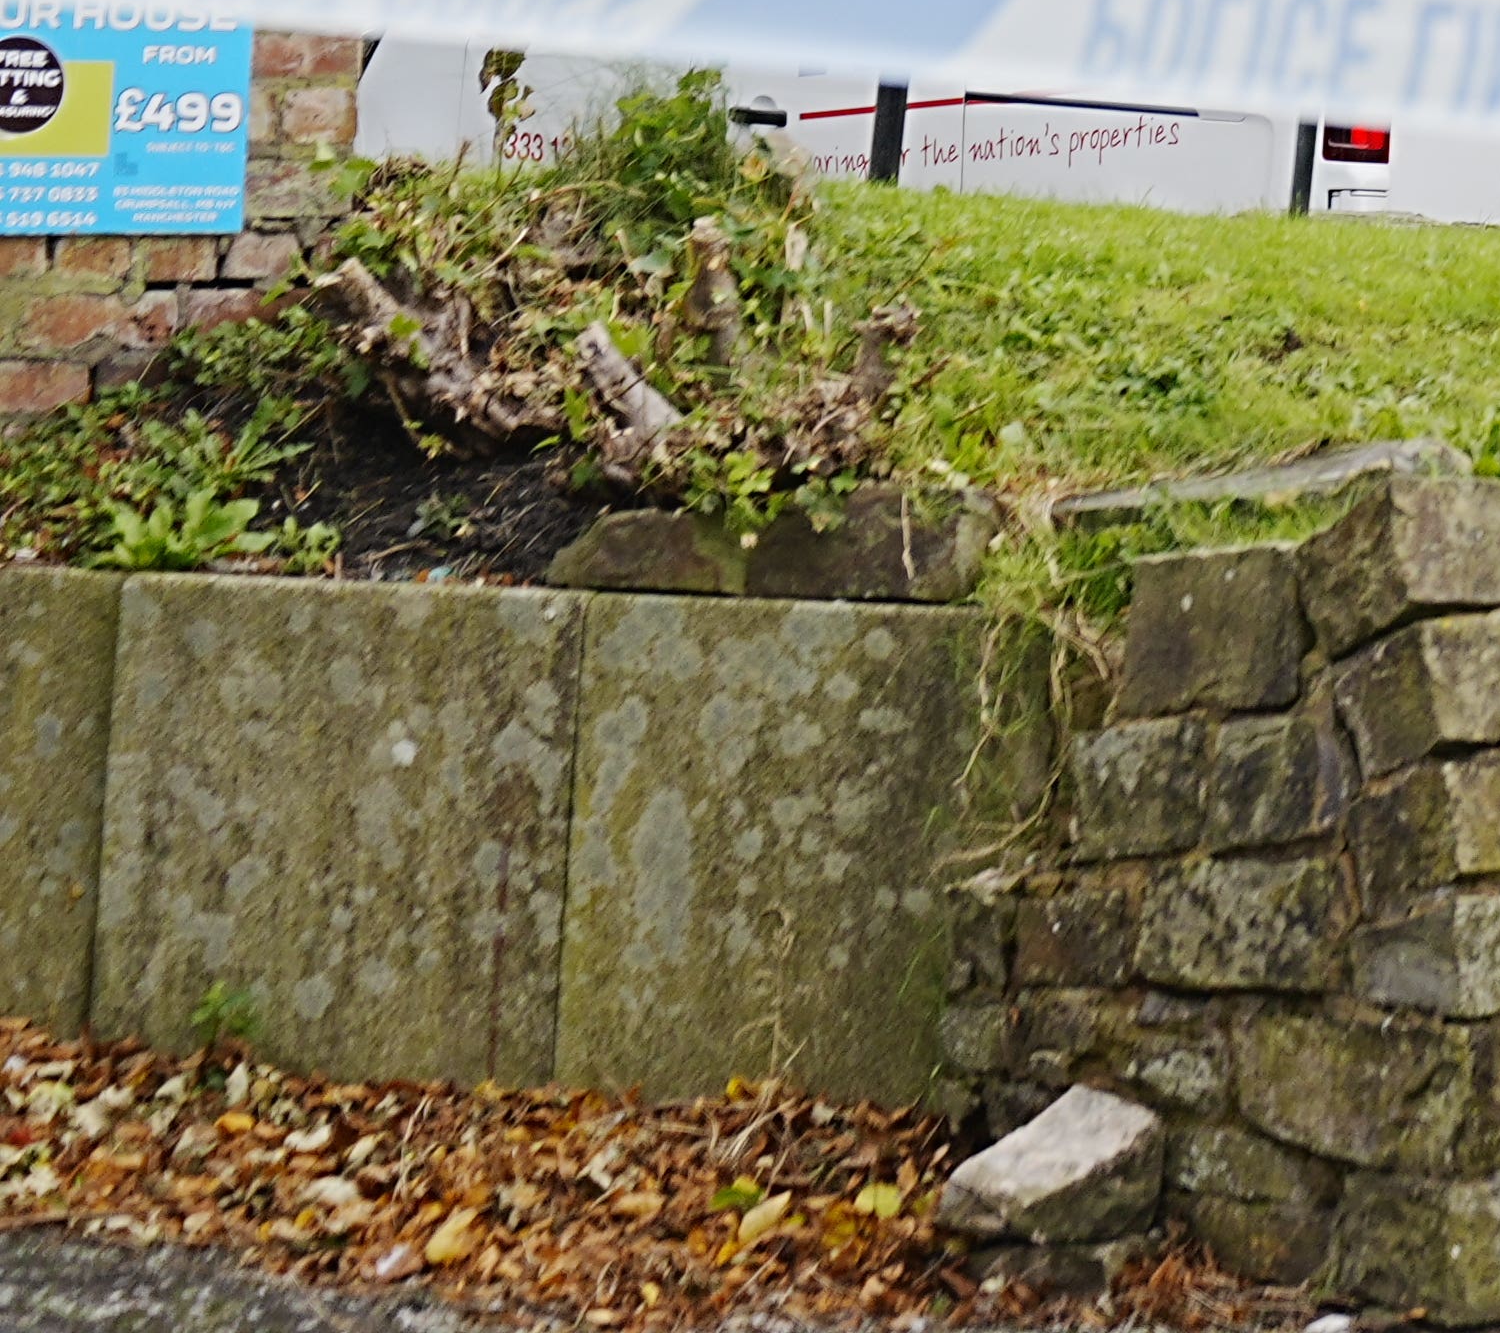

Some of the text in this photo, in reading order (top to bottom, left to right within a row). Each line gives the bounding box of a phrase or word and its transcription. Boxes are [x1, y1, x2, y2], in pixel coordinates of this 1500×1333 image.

[142, 44, 218, 66] FROM
[10, 88, 29, 105] &
[112, 86, 243, 134] £499
[812, 145, 870, 176] aring
[922, 133, 960, 168] the
[968, 122, 1060, 162] nation's
[1068, 115, 1181, 169] properties
